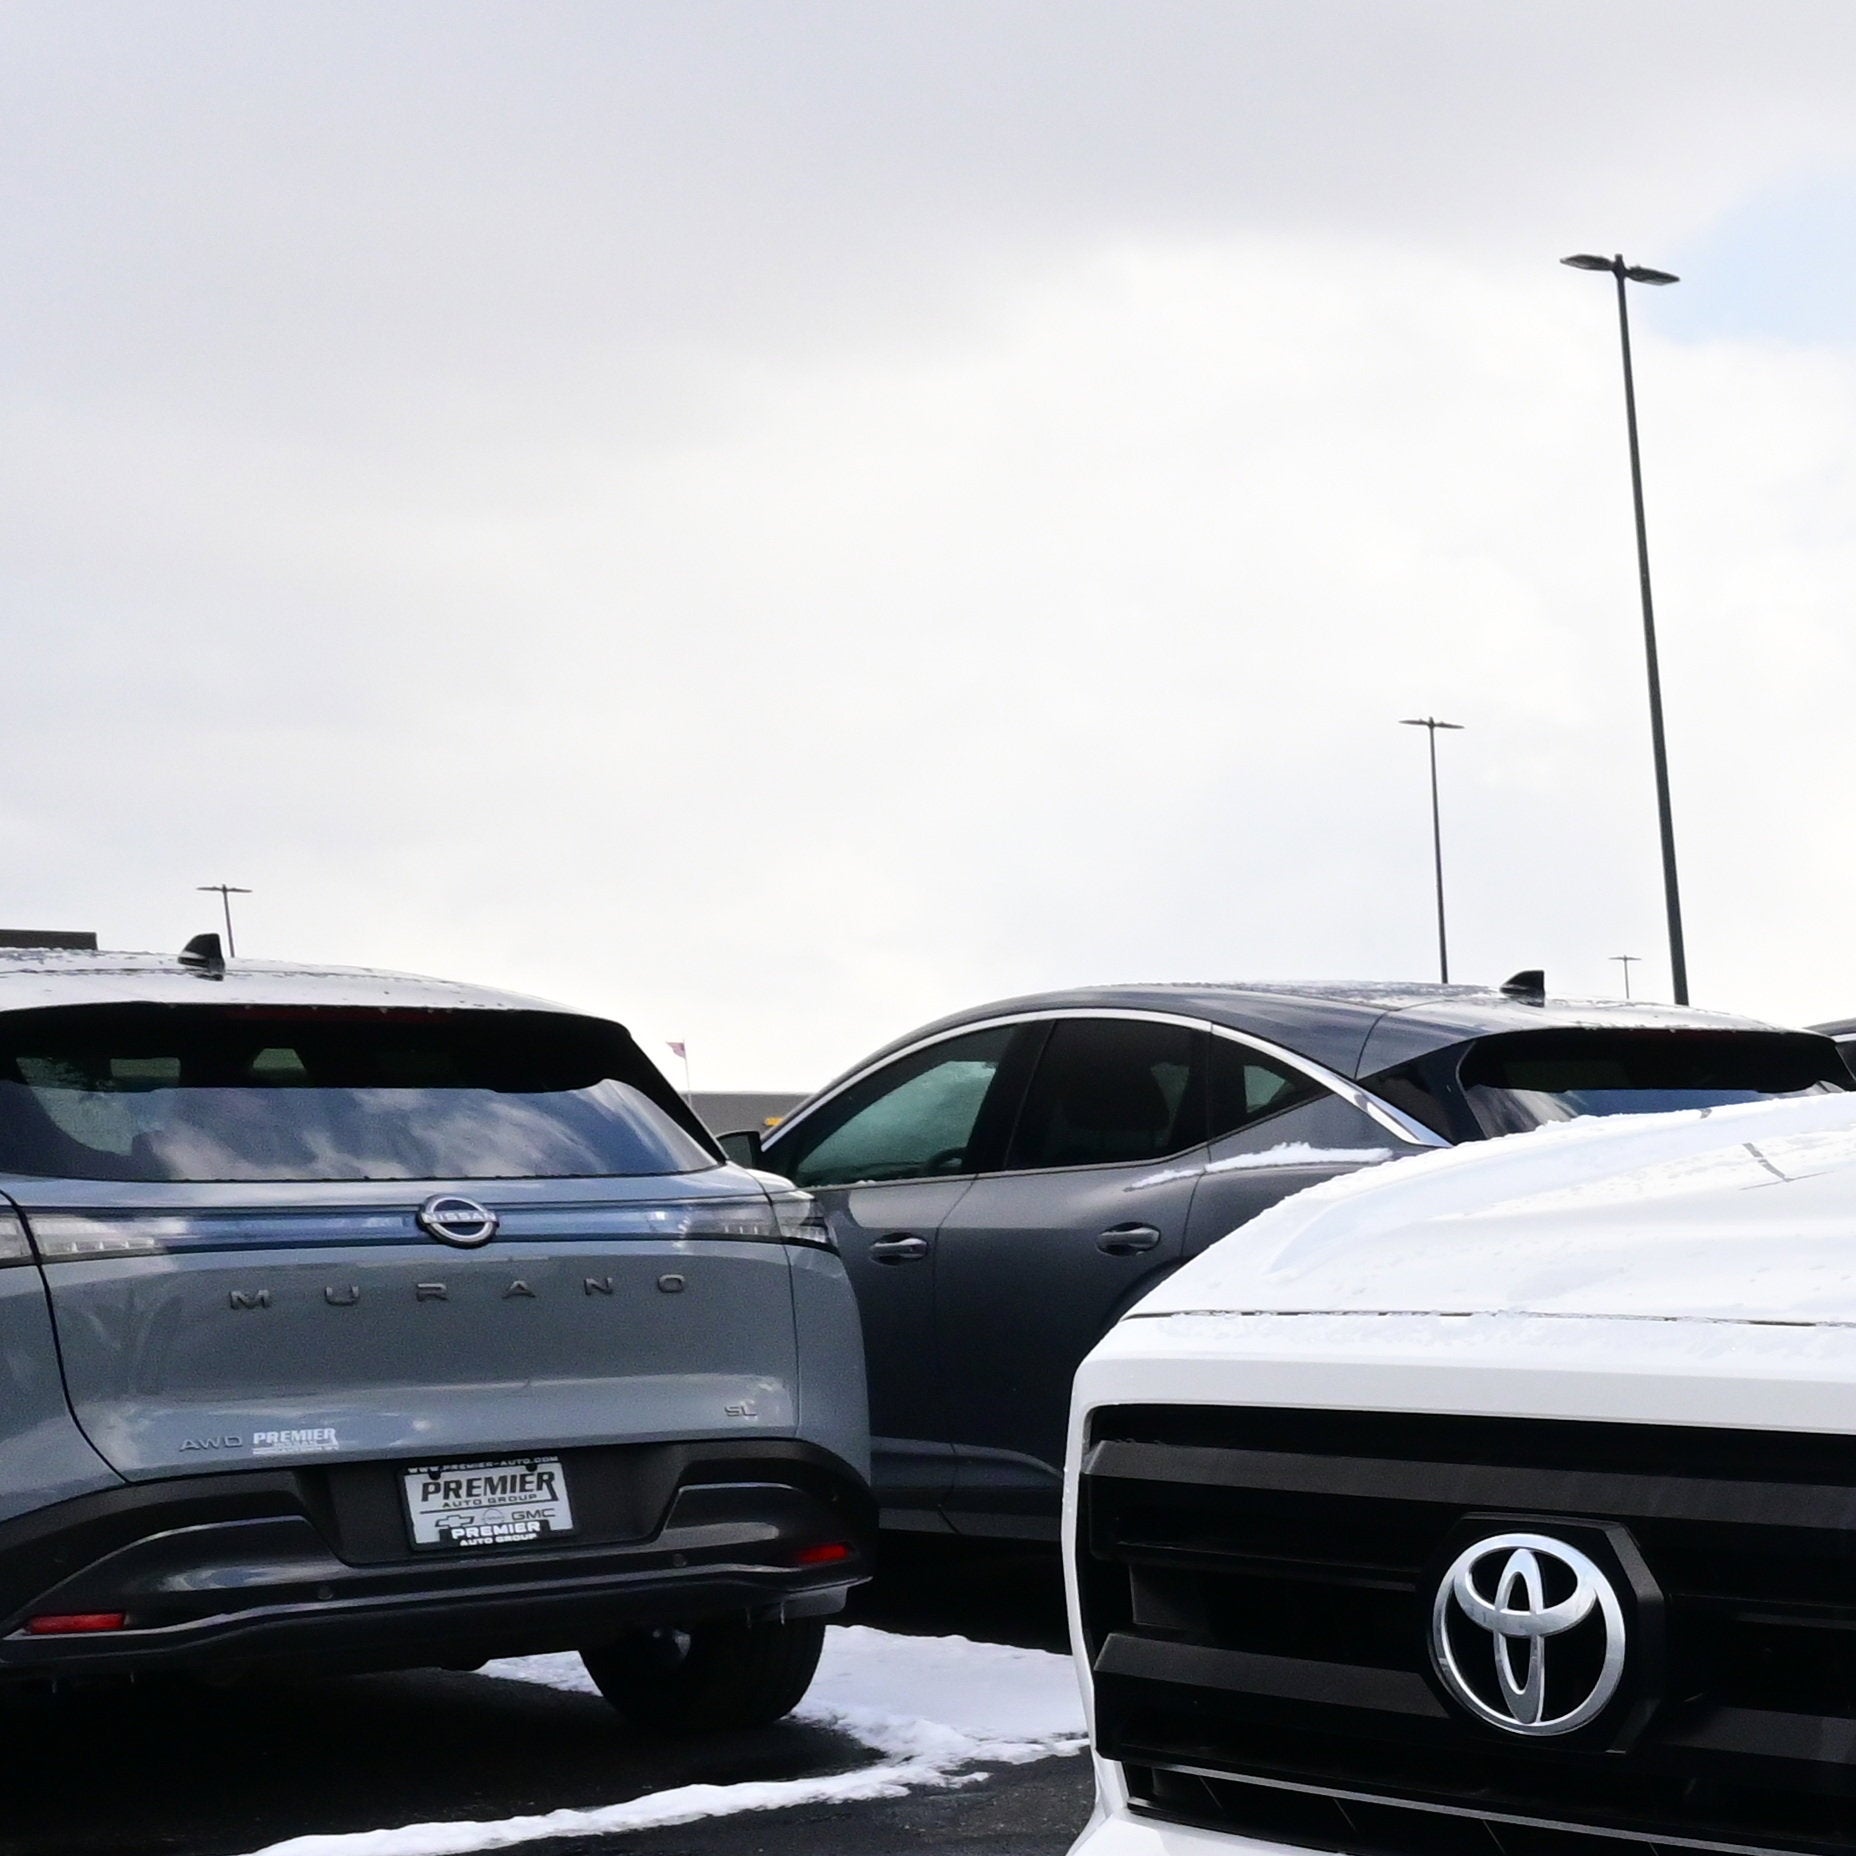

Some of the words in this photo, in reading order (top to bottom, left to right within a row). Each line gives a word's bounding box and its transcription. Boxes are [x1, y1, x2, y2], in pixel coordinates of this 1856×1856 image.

[421, 1210, 497, 1223] NISSAN
[228, 1273, 687, 1310] MURANO
[724, 1404, 758, 1418] SL
[179, 1435, 243, 1452] AWD
[253, 1428, 338, 1445] PREMIER
[421, 1471, 559, 1502] PREMIER
[442, 1499, 482, 1509] AUTO
[487, 1493, 538, 1504] GROUP
[511, 1508, 556, 1521] GMC
[451, 1521, 541, 1540] PREMIER
[459, 1536, 493, 1546] AUTO
[495, 1533, 538, 1543] GROUP
